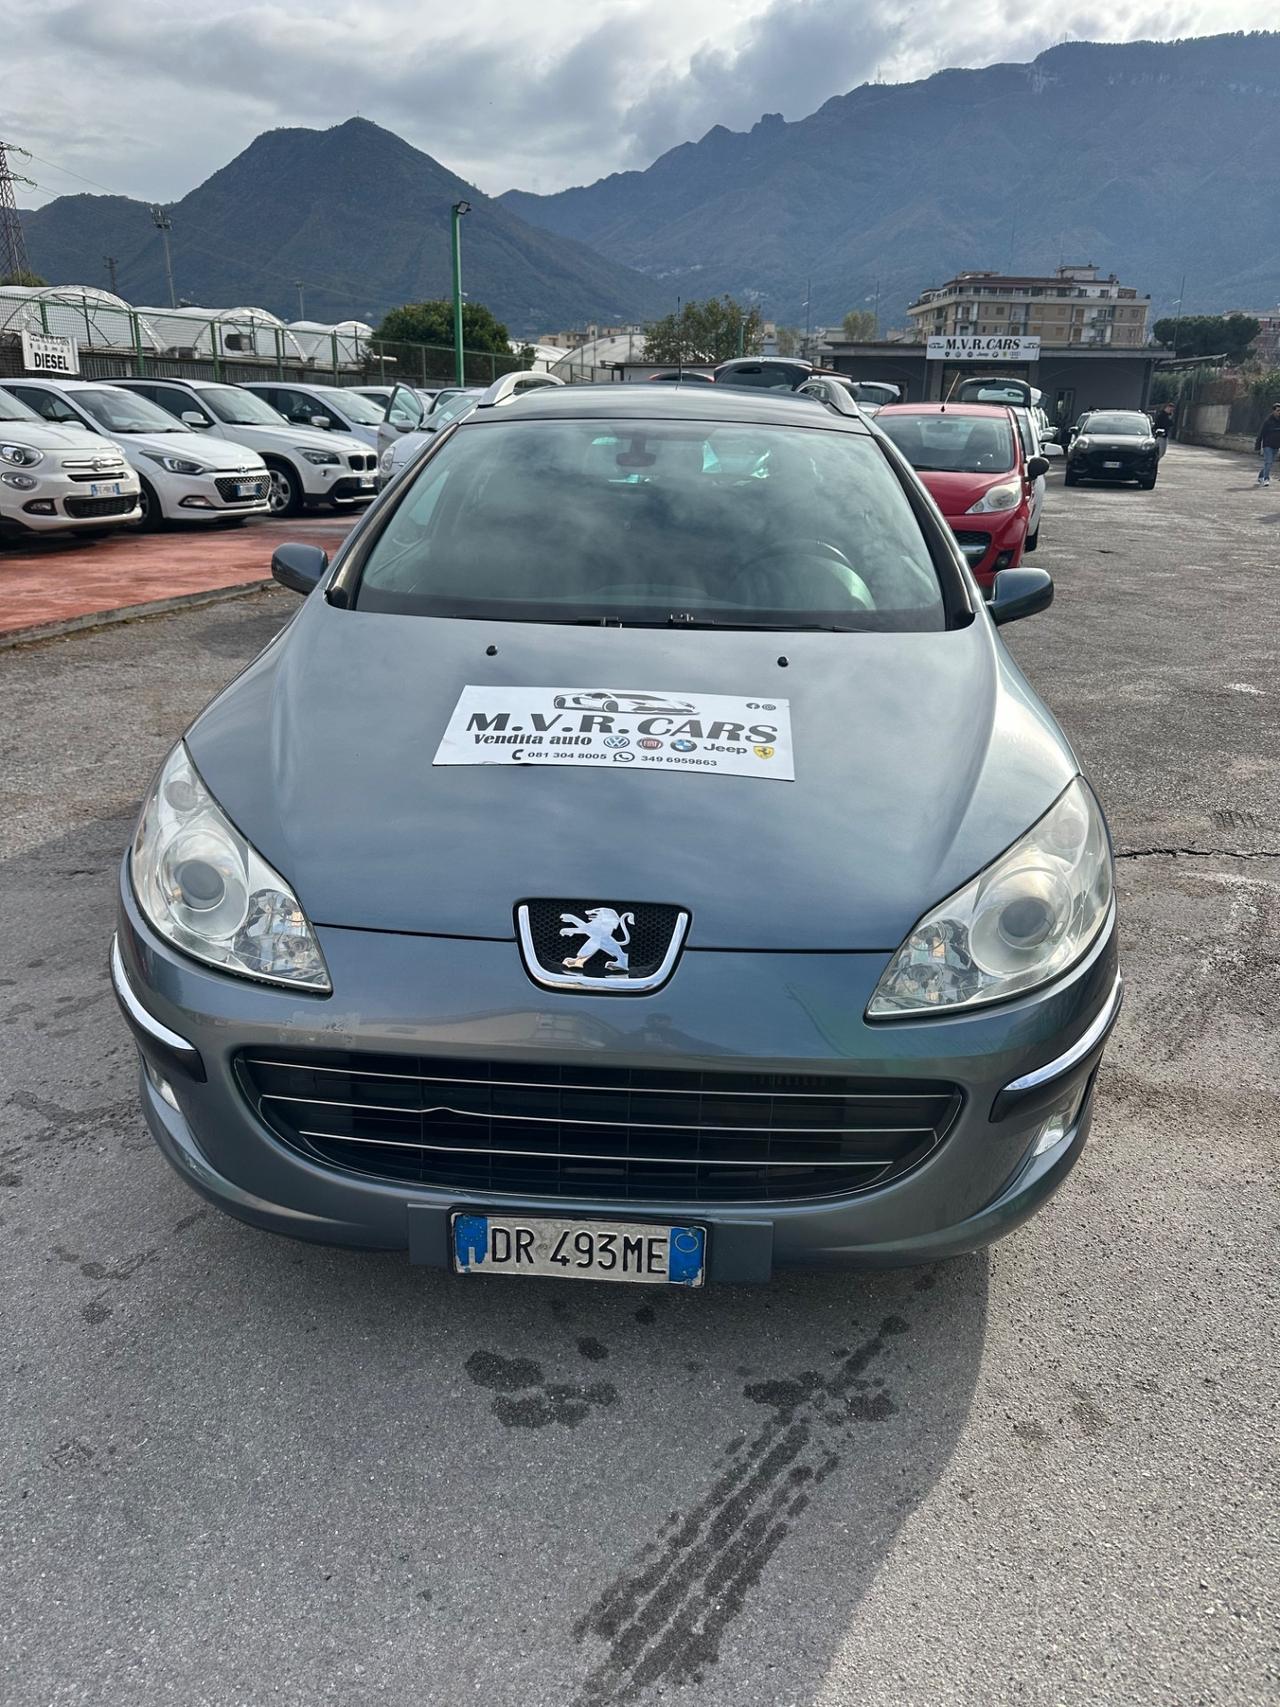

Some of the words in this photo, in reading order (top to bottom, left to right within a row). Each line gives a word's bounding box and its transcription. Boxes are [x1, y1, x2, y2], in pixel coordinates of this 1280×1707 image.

[946, 338, 1021, 350] M.V.R.CARS
[34, 352, 69, 371] DIESEL
[475, 734, 544, 745] Vendita
[549, 735, 592, 746] auto
[704, 743, 748, 755] Jeep
[527, 751, 549, 759] 081
[553, 751, 575, 759] 304
[578, 752, 607, 760] 8005
[666, 756, 718, 767] 6959863
[491, 1226, 535, 1264] DR
[550, 1230, 668, 1275] 493ME
